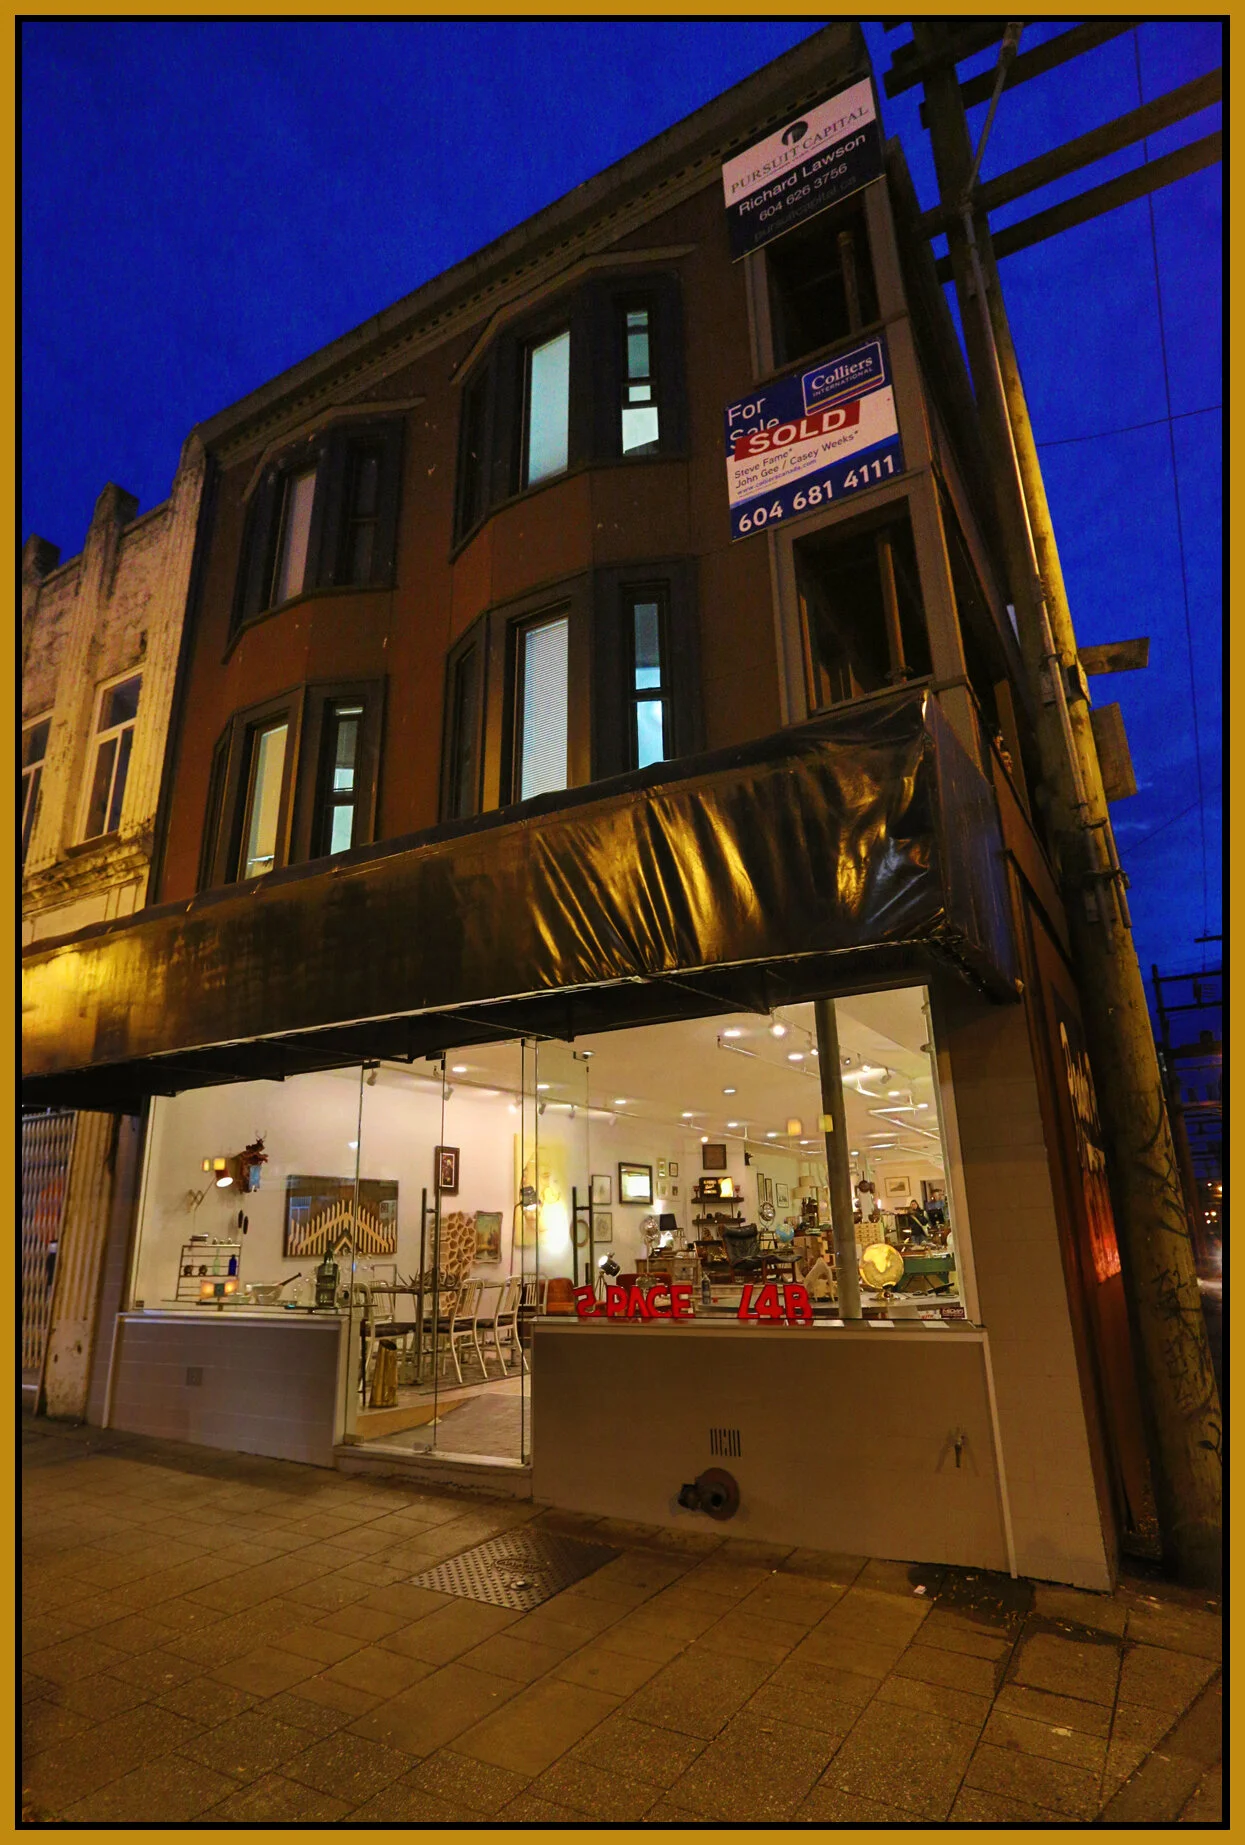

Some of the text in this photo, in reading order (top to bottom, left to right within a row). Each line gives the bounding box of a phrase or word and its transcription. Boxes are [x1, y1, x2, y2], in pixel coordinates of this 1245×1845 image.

[731, 145, 800, 194] PURSUIT
[803, 106, 869, 149] CAPITAL
[739, 173, 798, 216] Richard
[802, 134, 866, 177] Lawson
[760, 162, 848, 221] 604 626 3756
[811, 357, 873, 390] Colliers
[813, 368, 873, 397] INTERNATIONAL
[728, 398, 767, 427] For
[748, 409, 846, 454] SOLD
[734, 464, 760, 480] Steve
[735, 474, 759, 489] John
[760, 465, 780, 478] Gee
[789, 448, 819, 466] Casey
[738, 500, 784, 533] 604
[792, 480, 833, 511] 681
[843, 454, 895, 488] 4111
